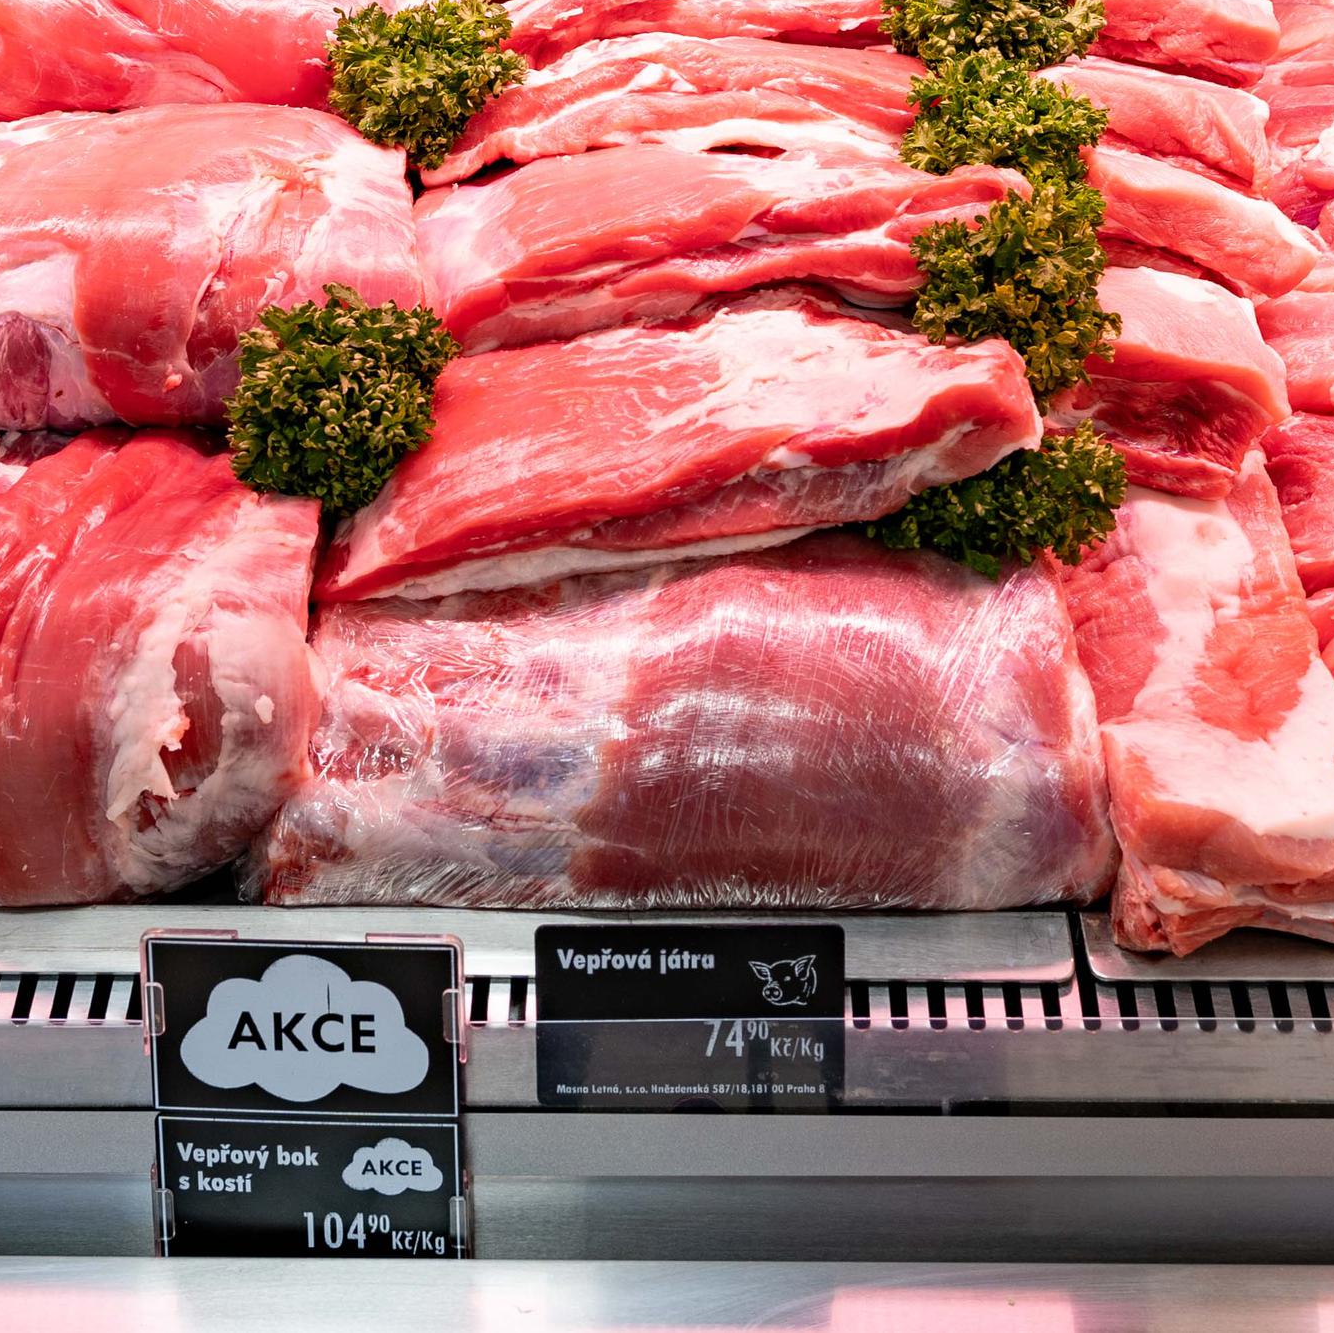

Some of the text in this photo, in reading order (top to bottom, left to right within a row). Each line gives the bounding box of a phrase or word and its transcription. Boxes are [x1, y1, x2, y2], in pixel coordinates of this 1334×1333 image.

[557, 949, 715, 975] Vepřová játra
[227, 1011, 376, 1053] AKCE
[771, 1038, 824, 1061] Kč/Kg
[557, 1084, 589, 1093] Masna
[592, 1084, 622, 1095] Letná,
[713, 1084, 767, 1095] 587/18,181
[772, 1085, 784, 1093] 00
[787, 1084, 815, 1093] Praha
[819, 1084, 825, 1093] 8
[177, 1142, 319, 1169] Vepřový bok
[361, 1159, 423, 1176] AKCE
[179, 1171, 252, 1193] s kostí
[392, 1230, 445, 1255] Kč/Kg
